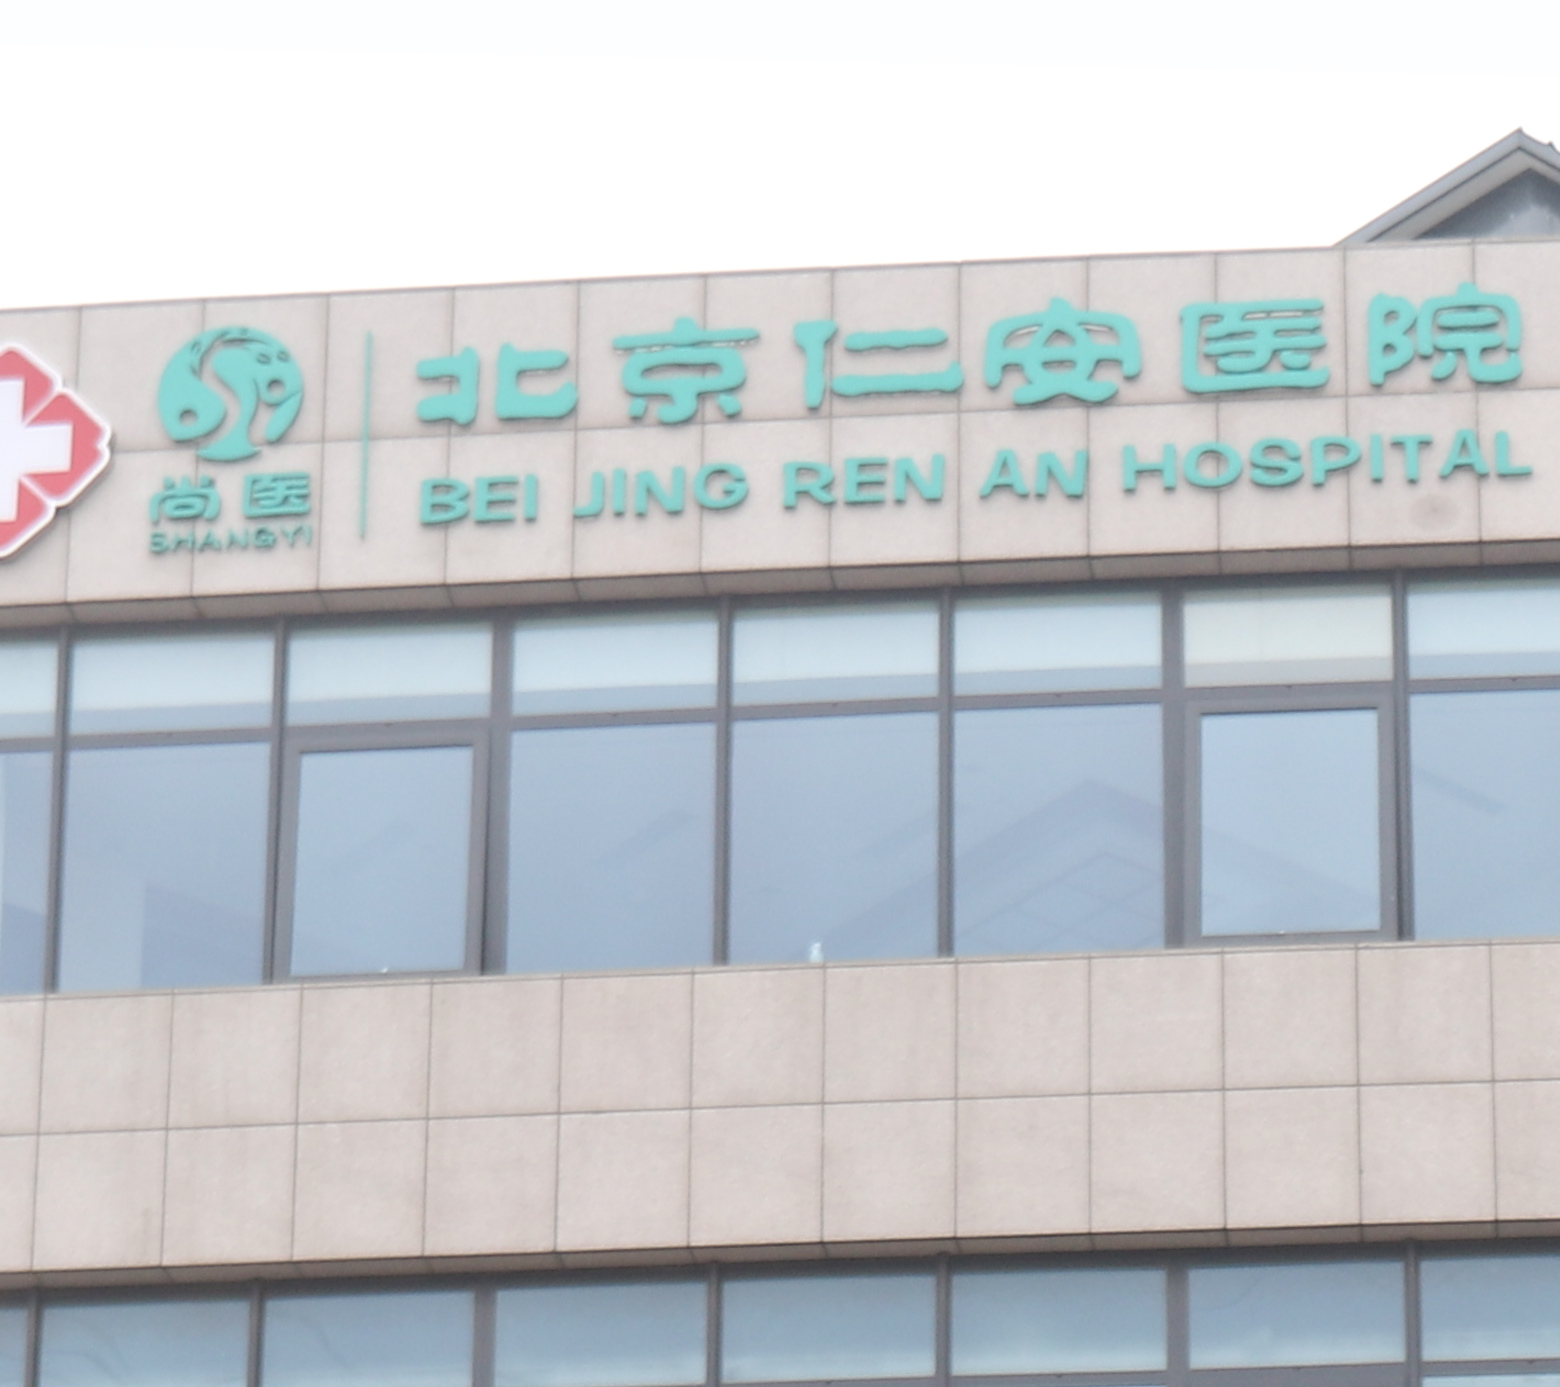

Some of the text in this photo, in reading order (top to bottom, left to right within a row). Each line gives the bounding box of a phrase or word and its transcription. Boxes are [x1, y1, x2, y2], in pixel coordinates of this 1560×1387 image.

[416, 283, 1523, 425] 北京仁安医院
[148, 471, 312, 523] 尚医
[419, 428, 1534, 526] BEI JING REN AN HOSPITAL
[149, 524, 313, 555] SHANGYI
